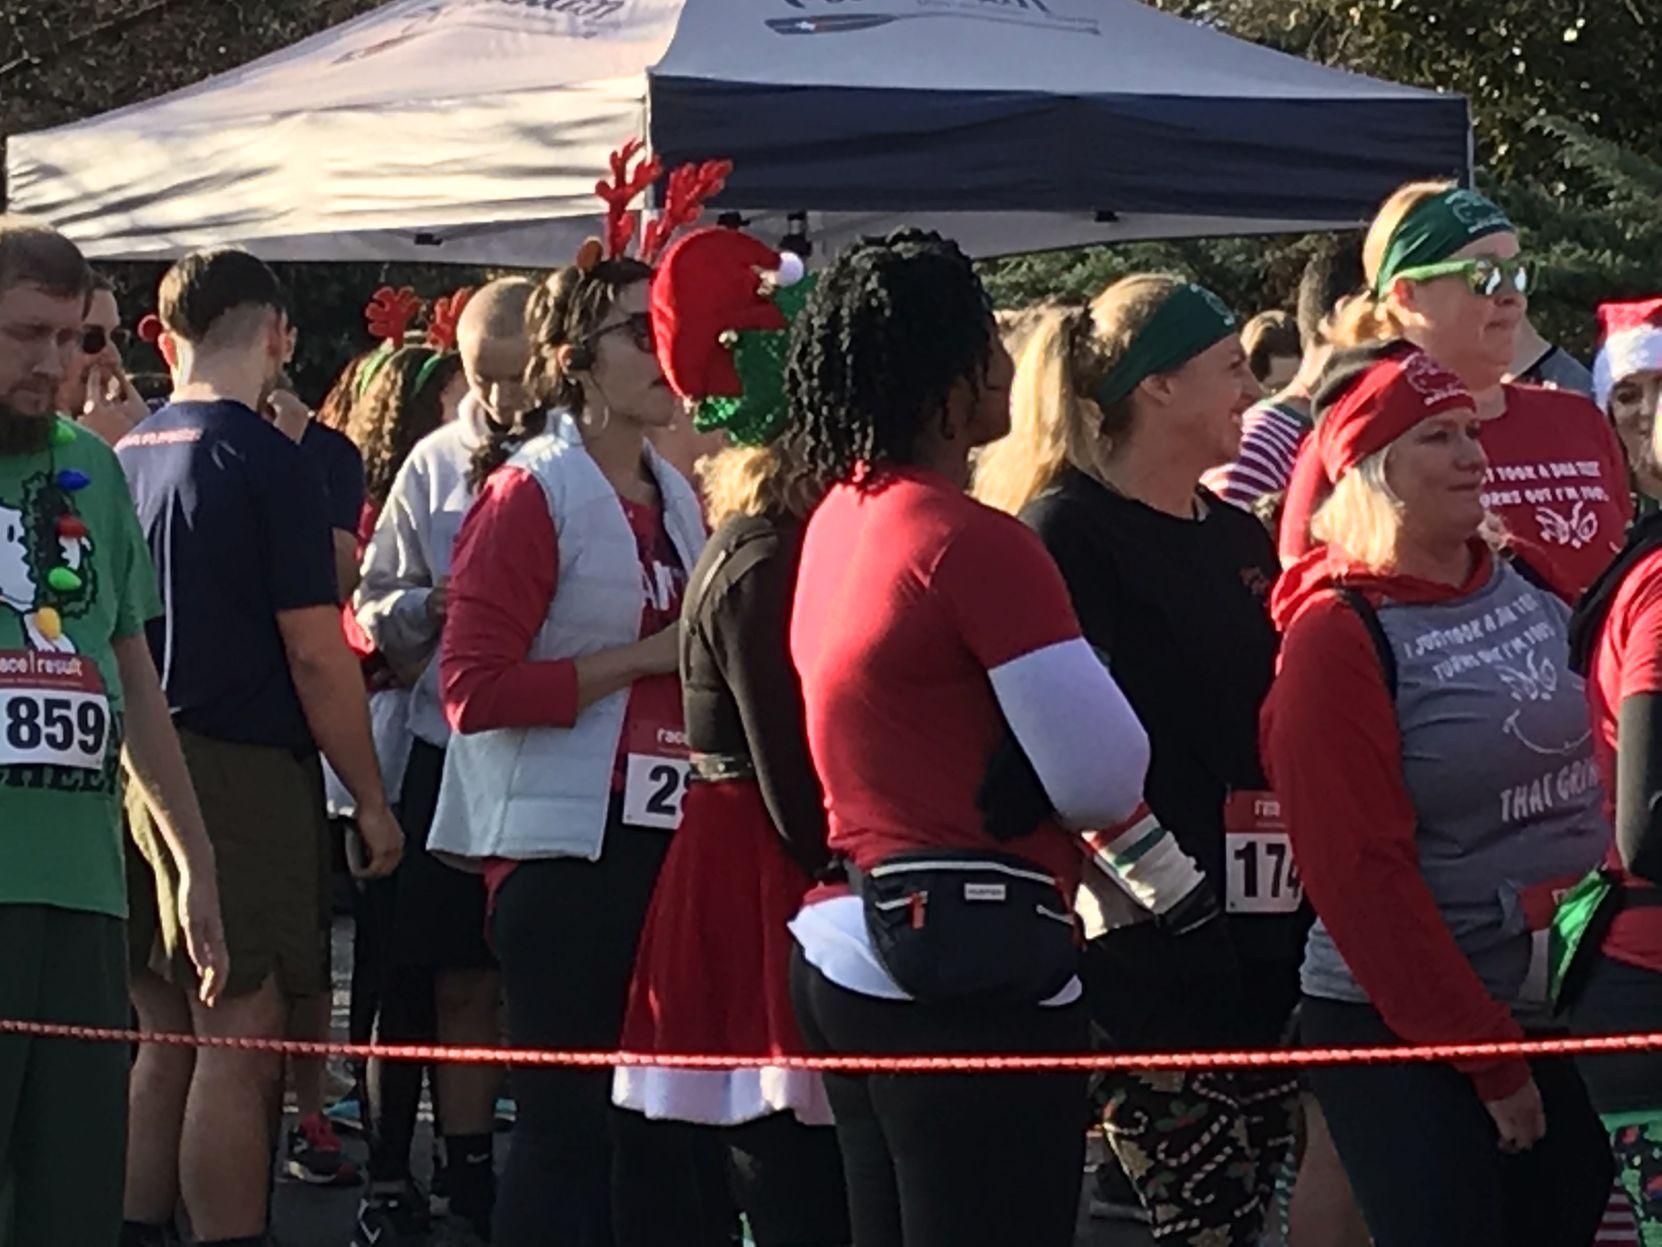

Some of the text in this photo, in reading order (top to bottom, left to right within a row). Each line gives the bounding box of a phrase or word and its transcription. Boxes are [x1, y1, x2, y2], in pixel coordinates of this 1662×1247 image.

[6, 696, 106, 756] 859
[645, 764, 690, 817] 2
[1500, 772, 1553, 822] THAT
[1233, 841, 1302, 900] 174
